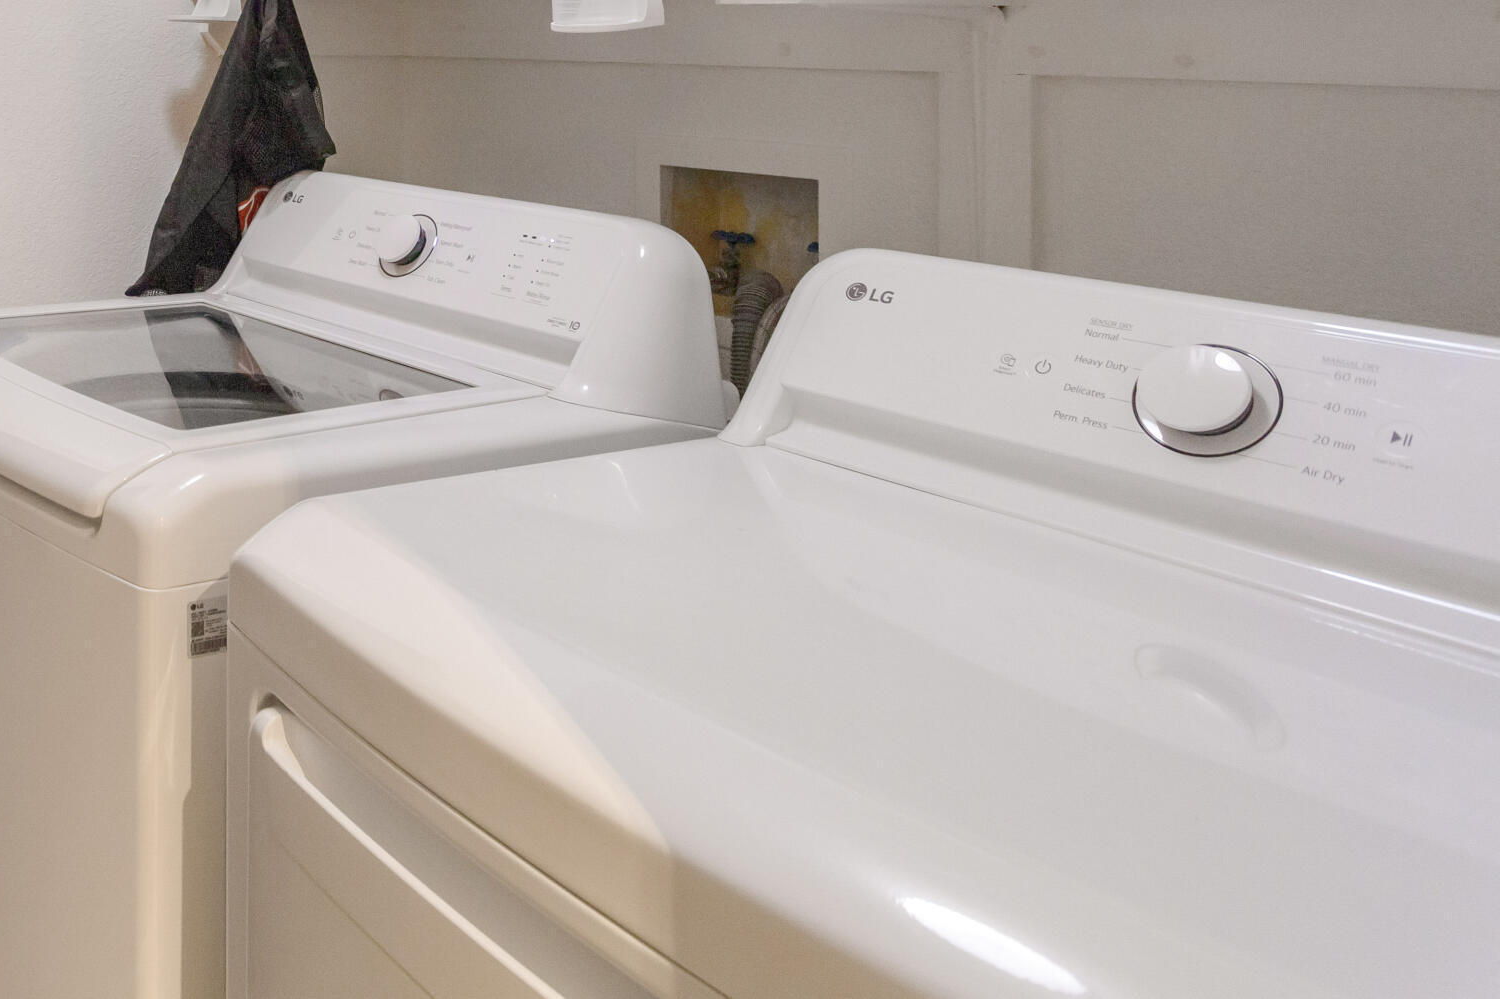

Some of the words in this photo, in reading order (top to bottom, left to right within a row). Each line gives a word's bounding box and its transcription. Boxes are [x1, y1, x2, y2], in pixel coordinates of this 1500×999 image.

[1084, 328, 1120, 342] Normal
[1074, 354, 1103, 369] Heavy
[1105, 360, 1129, 373] Duty
[1333, 371, 1352, 382] 60
[1354, 375, 1377, 387] min
[1063, 383, 1106, 399] Delicates
[1323, 402, 1341, 413] 40
[1343, 406, 1367, 418] min
[1053, 410, 1078, 423] Perm.
[1082, 416, 1108, 430] Press
[1312, 434, 1330, 446] 20
[1333, 438, 1356, 451] min
[1300, 465, 1320, 478] Air
[1323, 470, 1346, 485] Dry
